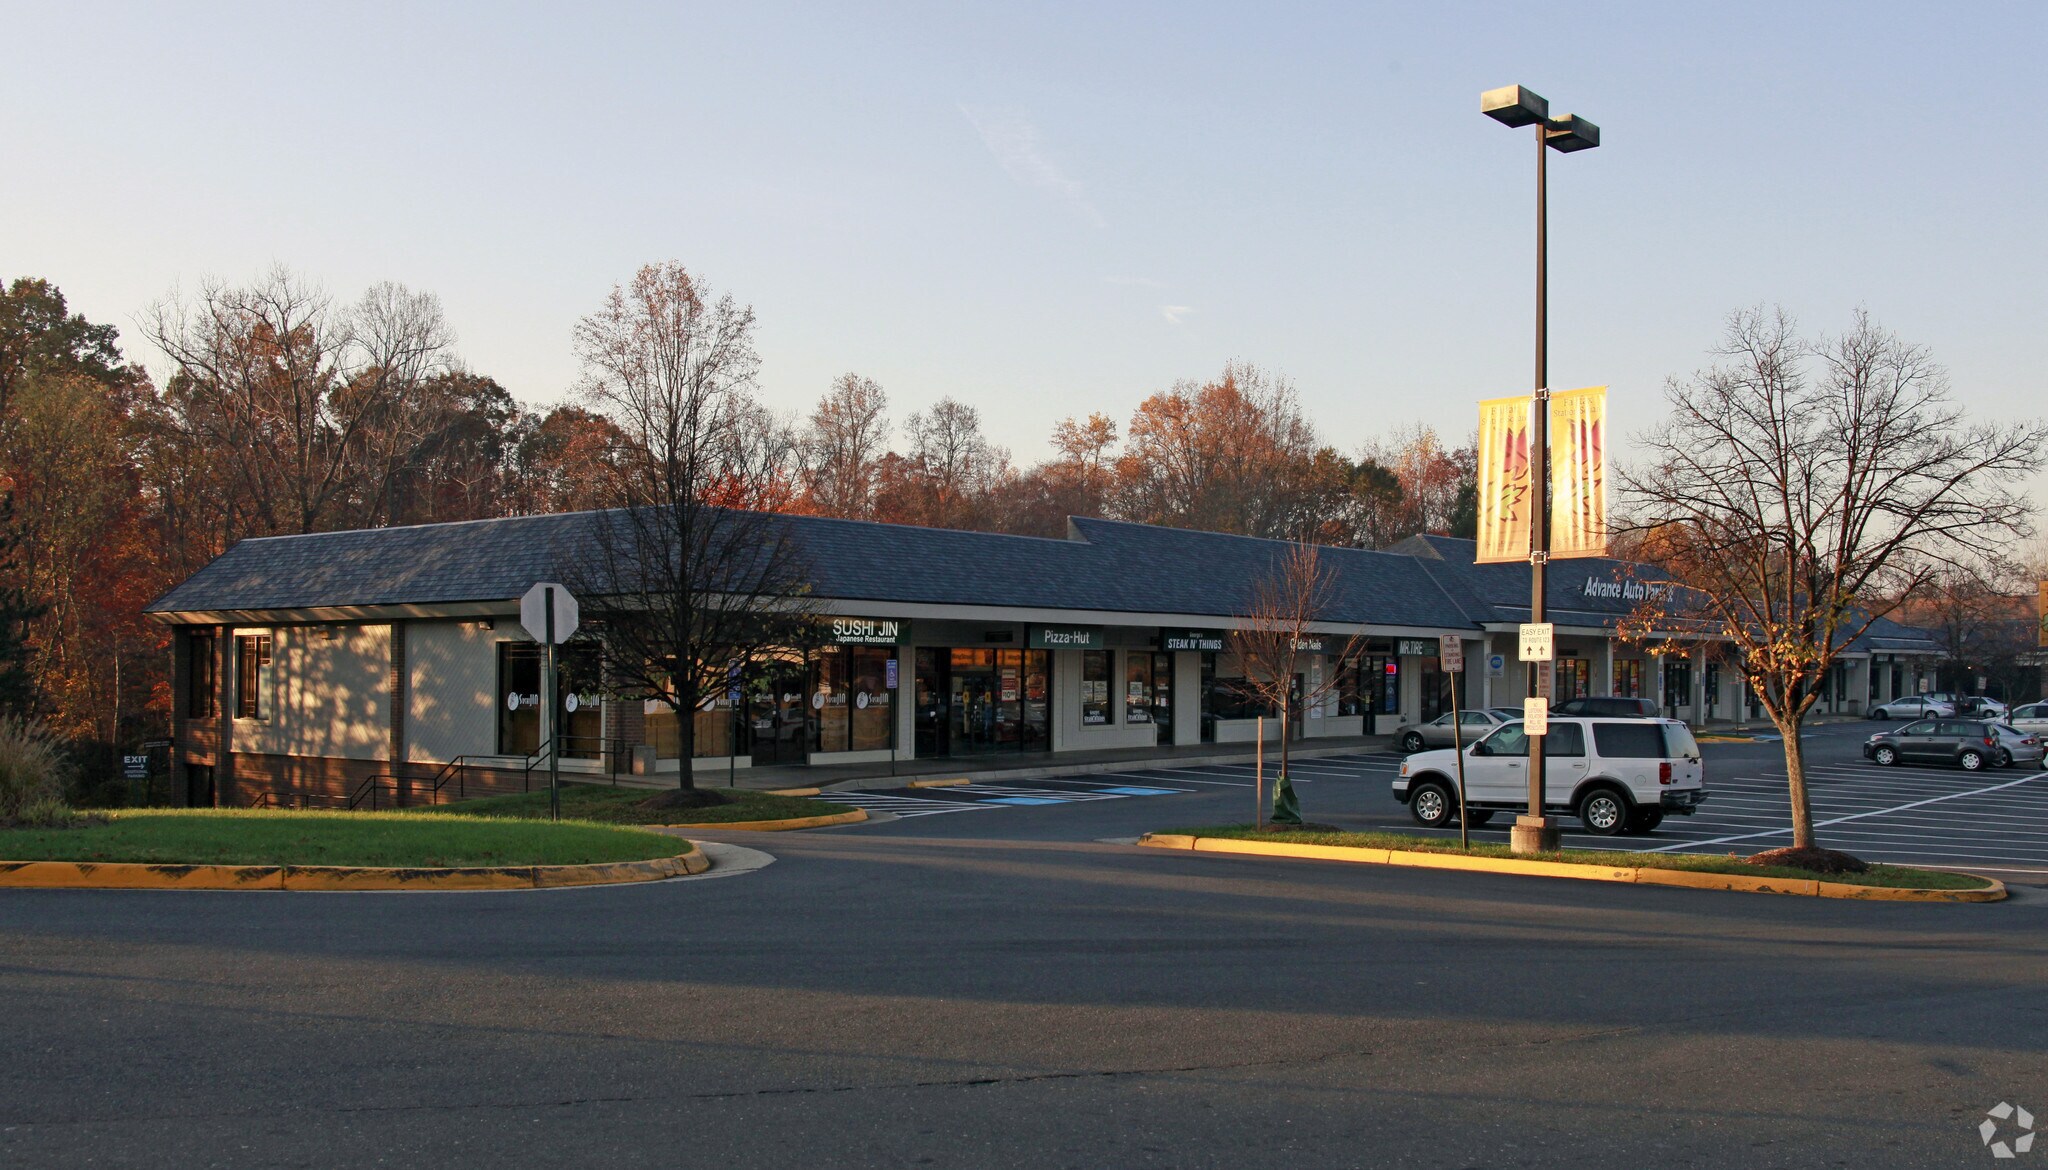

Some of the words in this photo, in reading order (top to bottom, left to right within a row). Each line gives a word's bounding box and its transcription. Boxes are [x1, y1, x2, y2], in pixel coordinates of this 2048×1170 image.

[1584, 576, 1621, 597] Advance
[1623, 580, 1644, 600] Auto
[833, 619, 875, 636] SUSHI
[878, 621, 899, 637] JIN
[1521, 628, 1537, 636] EASY
[1538, 628, 1550, 636] EXIT
[835, 635, 864, 643] Japanese
[1044, 629, 1090, 644] Pizza-Hut
[1168, 638, 1189, 649] STEAK
[1199, 640, 1222, 650] THINGS
[1290, 638, 1308, 650] Glden
